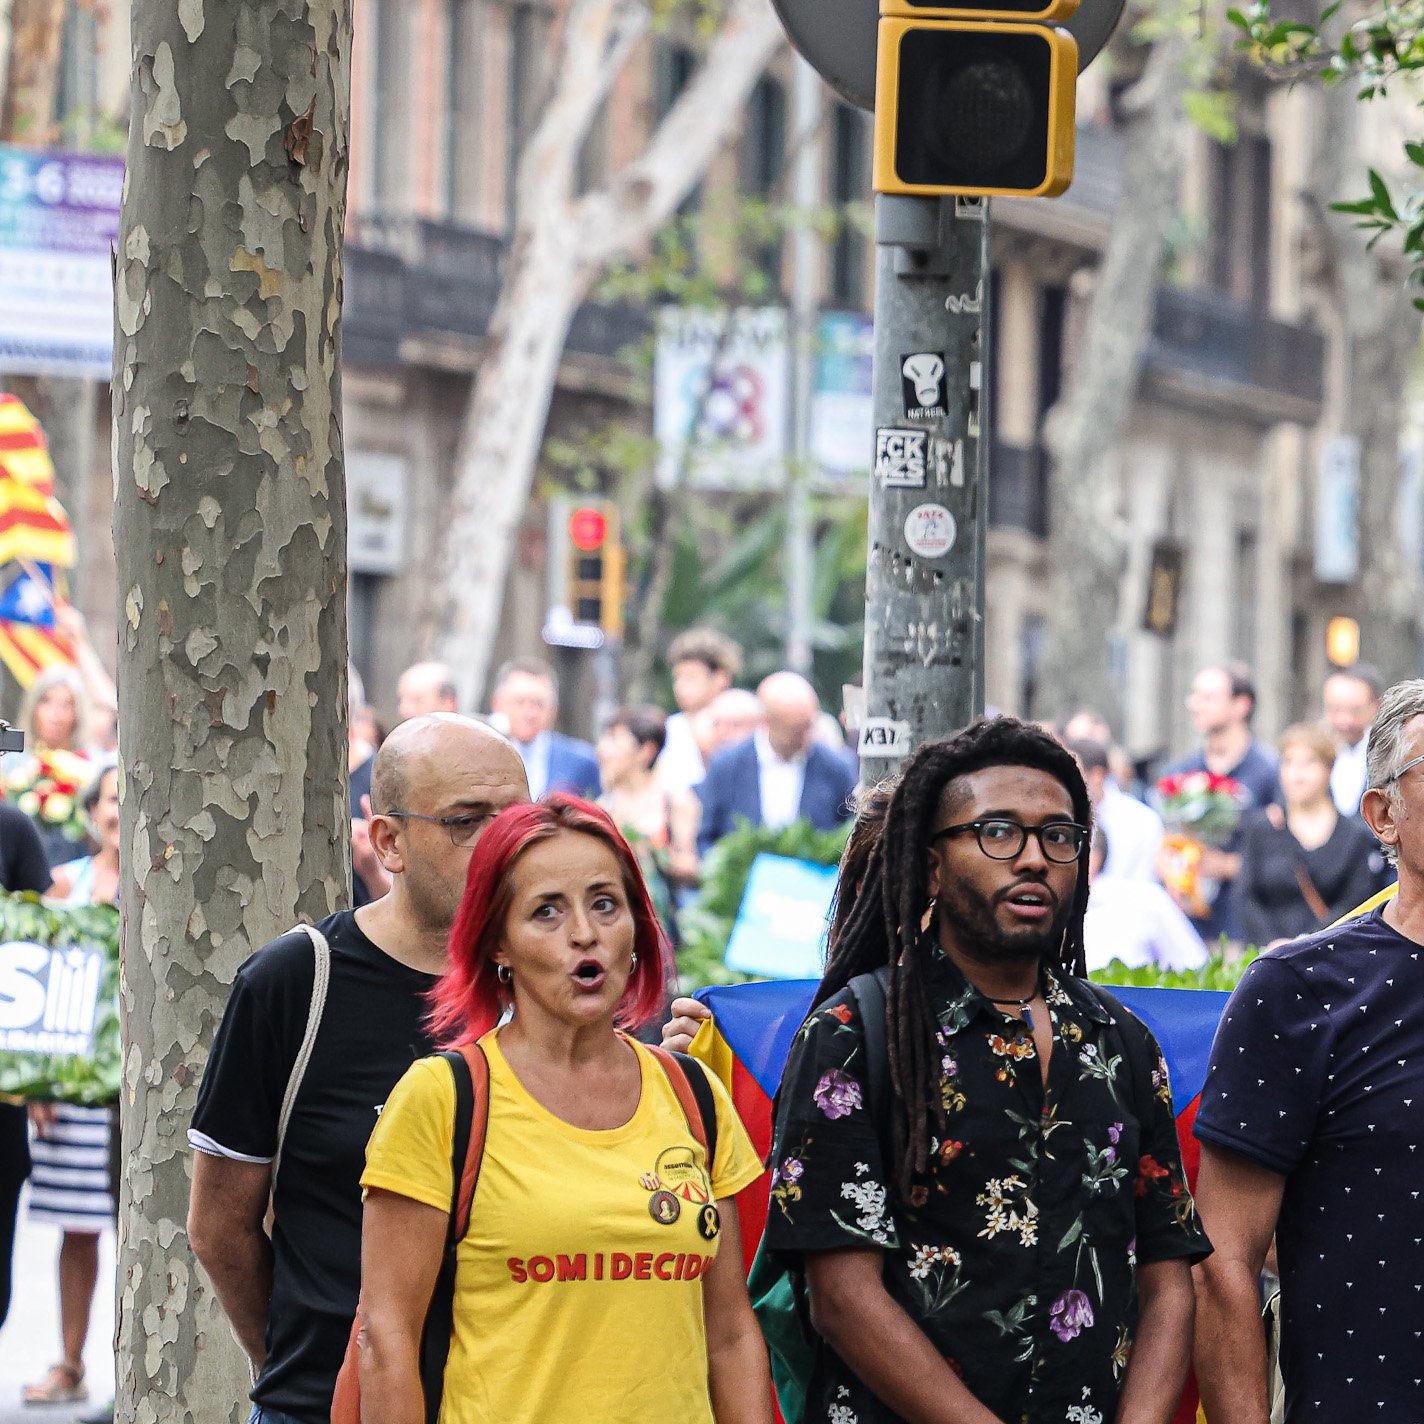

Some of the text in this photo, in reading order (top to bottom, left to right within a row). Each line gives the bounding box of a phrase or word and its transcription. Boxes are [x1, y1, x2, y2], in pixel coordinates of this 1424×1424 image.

[877, 435, 923, 458] FCK
[506, 1253, 586, 1283] SOM
[594, 1253, 603, 1281] I
